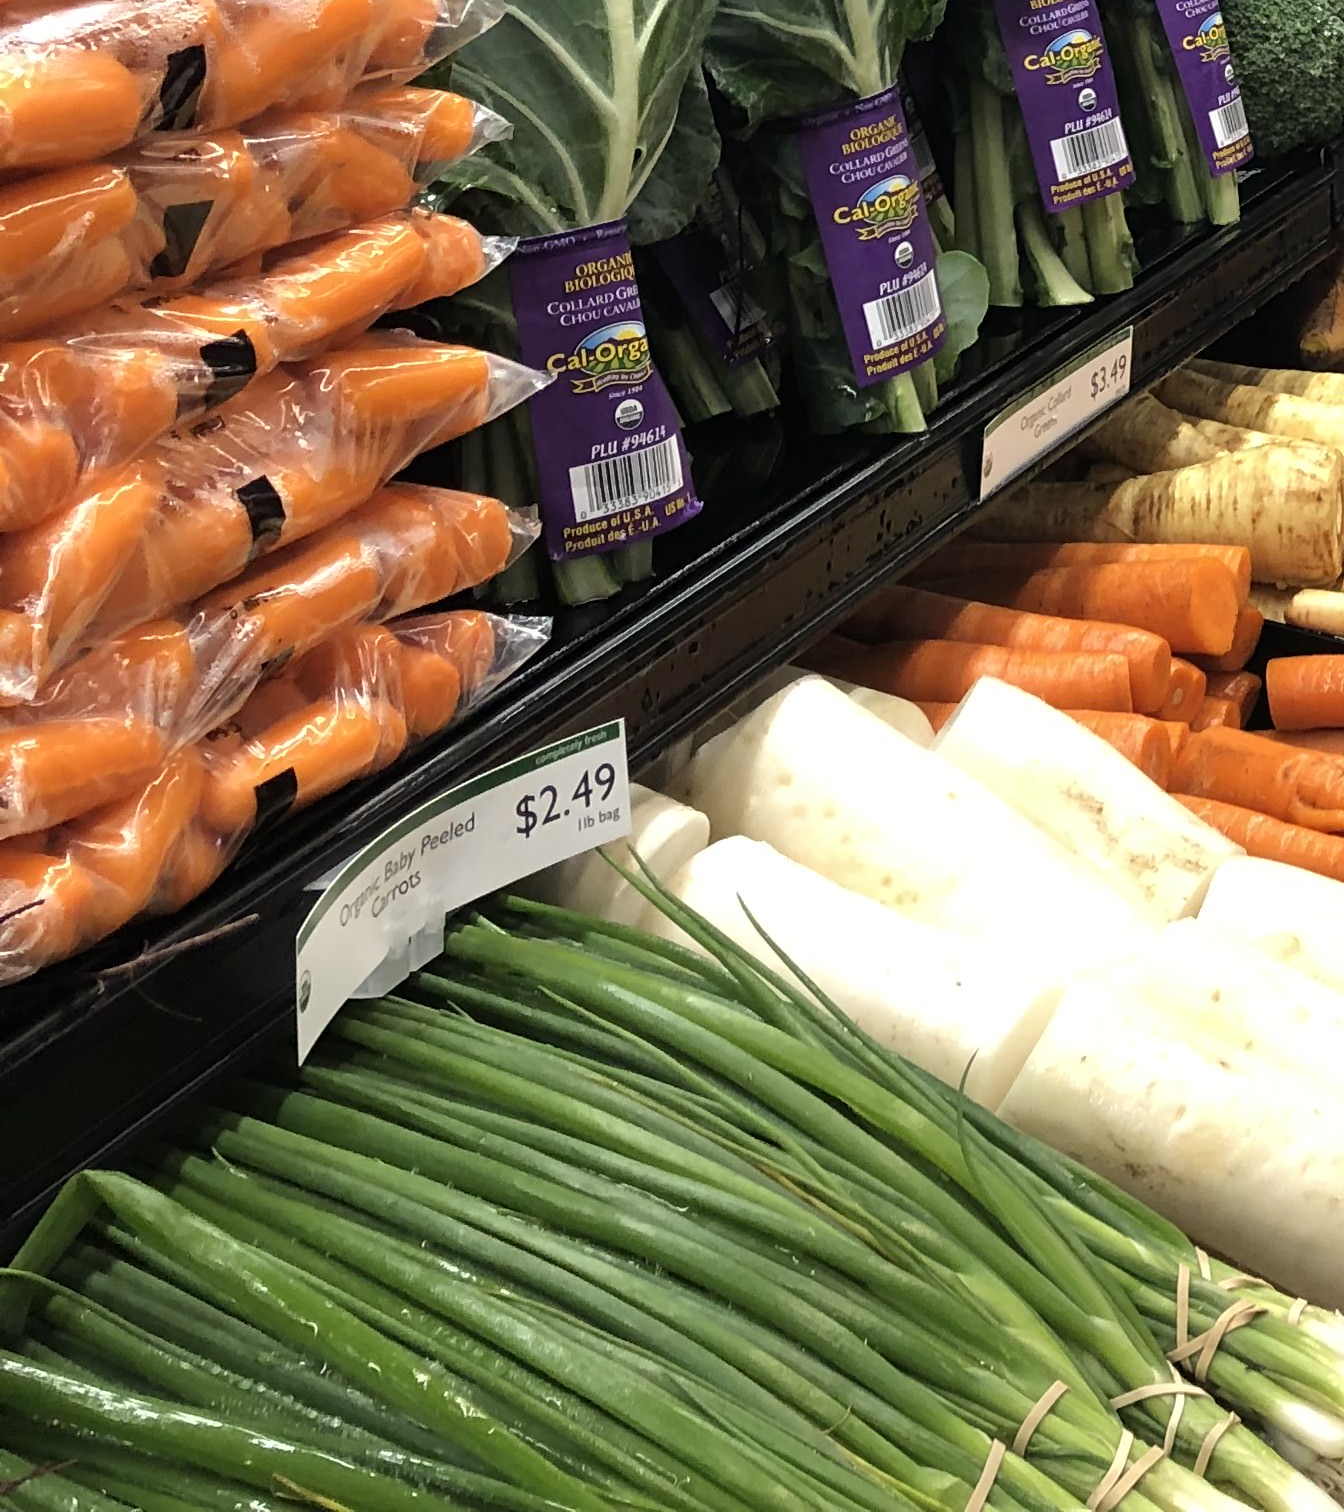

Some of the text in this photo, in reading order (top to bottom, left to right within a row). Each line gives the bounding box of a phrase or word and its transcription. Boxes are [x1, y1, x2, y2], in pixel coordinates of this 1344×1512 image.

[1019, 7, 1067, 27] COLLARD
[1030, 20, 1060, 35] CHOU
[1182, 26, 1226, 51] Cal-Or
[1064, 119, 1083, 134] PLU
[829, 150, 885, 175] COLLARD
[841, 167, 876, 184] CHOU
[565, 263, 636, 294] BIOLOGIQ
[879, 278, 900, 296] PLU
[547, 283, 639, 316] COLLARD GRE
[560, 298, 641, 327] CHOU CAVALI
[546, 337, 649, 375] Cal-Orga
[863, 345, 899, 365] Produce
[867, 357, 899, 376] Produit
[1090, 354, 1127, 402] $3.49
[591, 425, 666, 459] PLU #94614
[563, 509, 655, 538] Produce of U.S.A.
[565, 534, 605, 552] Produit
[607, 529, 626, 542] des
[534, 730, 607, 766] completely fresh
[515, 762, 616, 839] $2.49
[599, 807, 620, 825] bag
[338, 812, 476, 927] Organic Baby Peeled
[370, 870, 422, 919] Carrots
